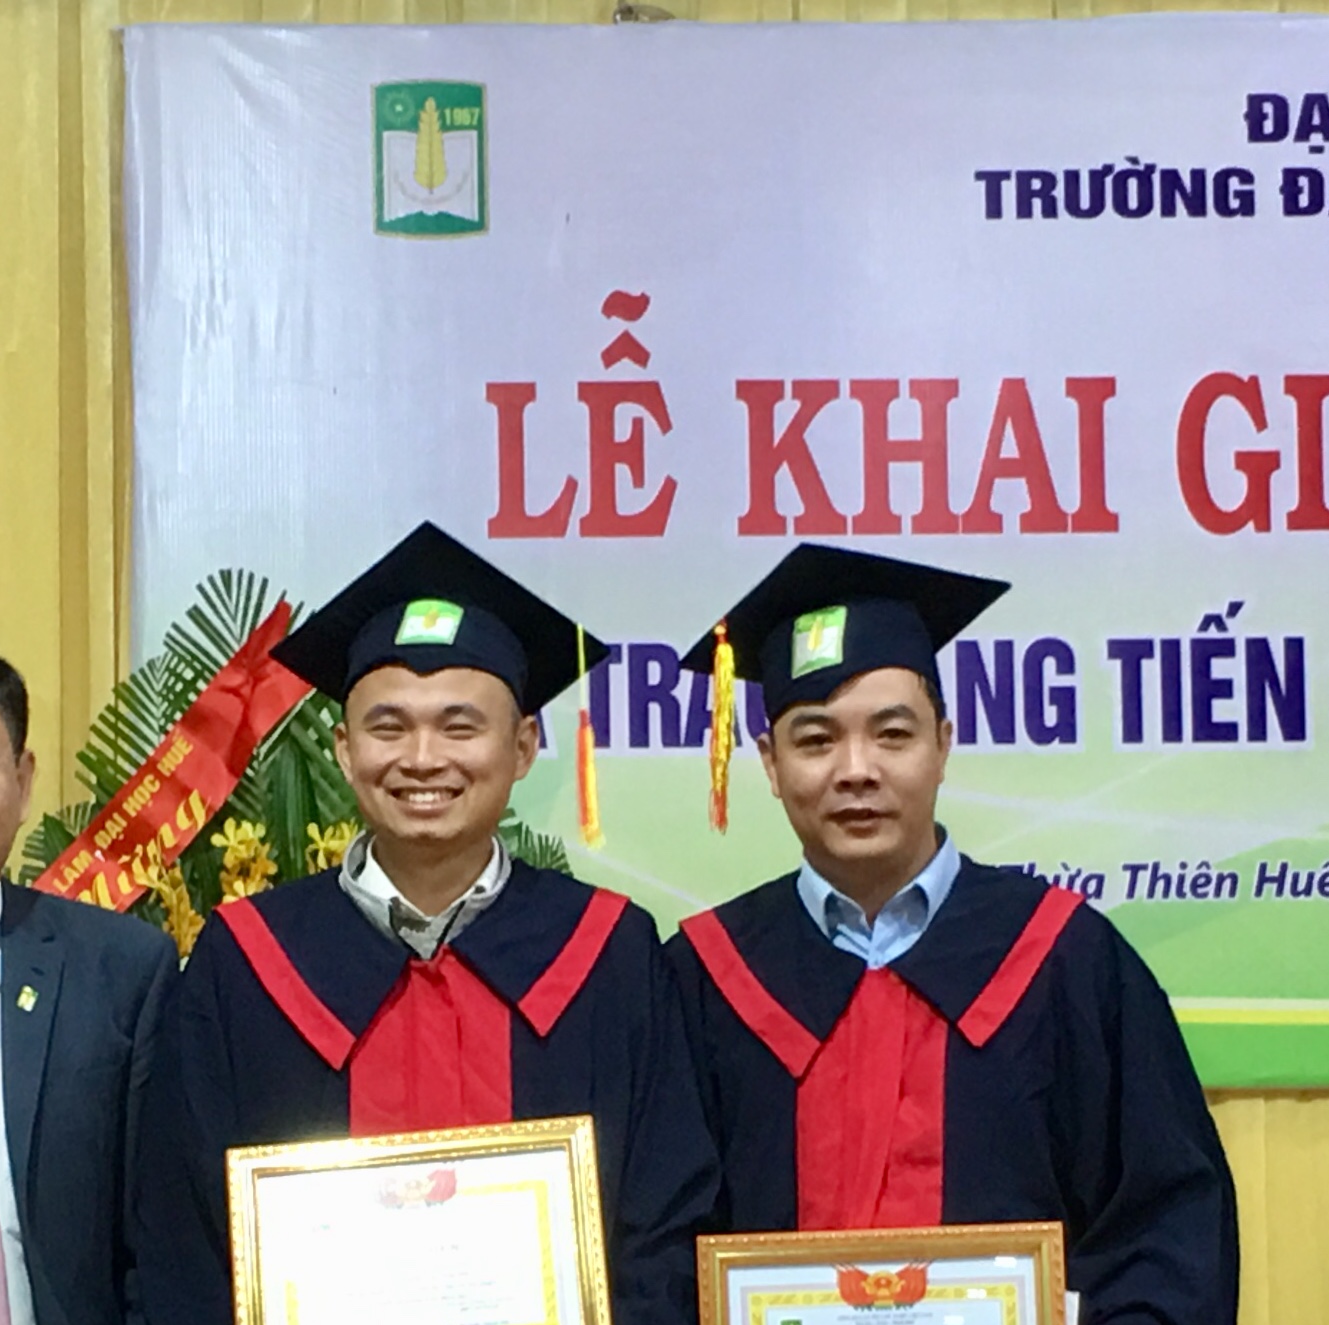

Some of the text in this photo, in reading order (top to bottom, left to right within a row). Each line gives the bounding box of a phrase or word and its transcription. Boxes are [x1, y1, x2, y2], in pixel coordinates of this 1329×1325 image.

[974, 158, 1256, 220] TRƯỜNG
[485, 288, 678, 539] LỄ
[735, 375, 1120, 537] KHAI
[1106, 600, 1307, 744] TIẾN
[94, 812, 128, 850] ĐẠI
[122, 774, 161, 818] HỌC
[156, 728, 194, 777] HUẾ
[1121, 861, 1239, 899] Thiên
